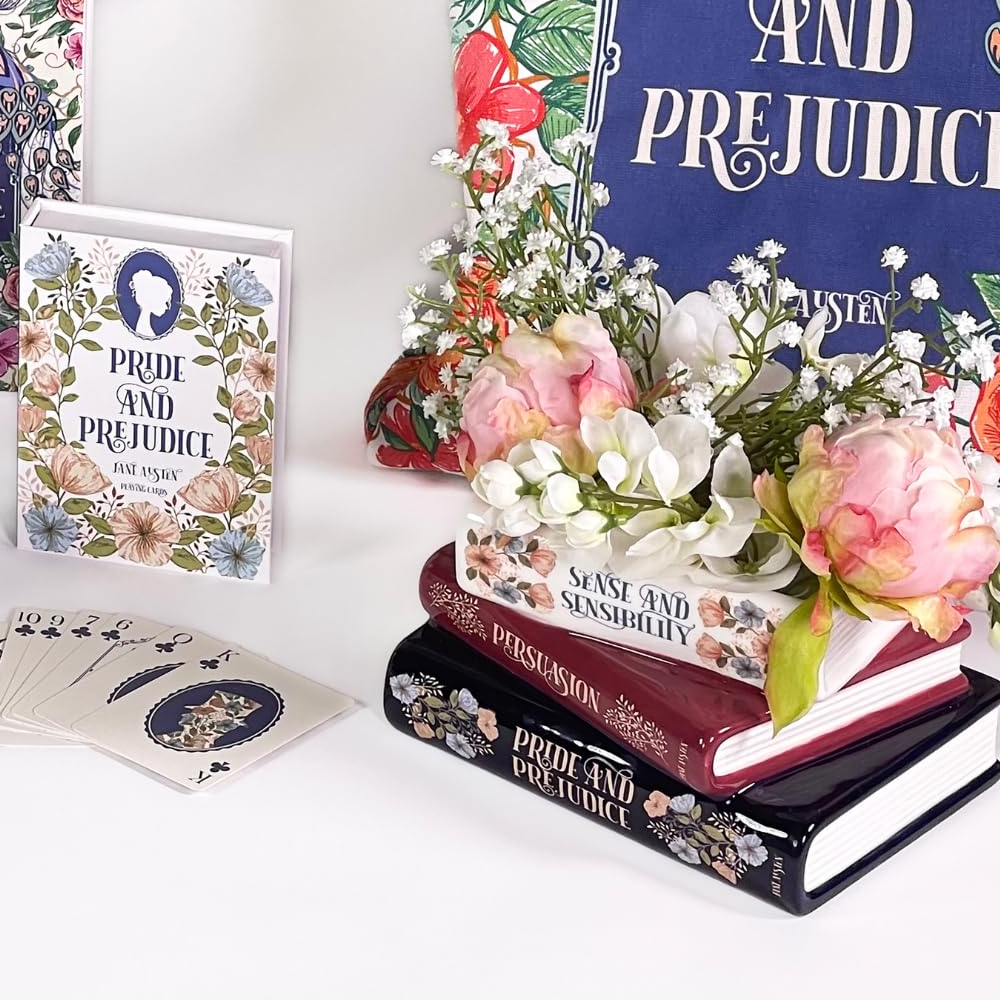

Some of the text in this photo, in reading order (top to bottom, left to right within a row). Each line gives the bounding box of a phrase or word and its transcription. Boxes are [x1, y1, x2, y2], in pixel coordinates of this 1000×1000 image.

[795, 288, 901, 333] AUSTEN
[110, 347, 186, 384] PRIDE
[117, 383, 174, 421] AND
[79, 416, 214, 459] PREJUDICE
[112, 461, 183, 483] JANE AUSTEN
[568, 566, 690, 620] SENSE AND
[18, 611, 42, 625] 10
[50, 615, 65, 626] 9
[86, 615, 100, 626] 7
[116, 619, 133, 630] 6
[561, 590, 696, 647] SENSIBILITY
[217, 649, 240, 662] K
[492, 622, 600, 714] PERSUASION
[512, 725, 635, 804] PRIDE AND
[512, 754, 632, 830] PREJUDICE
